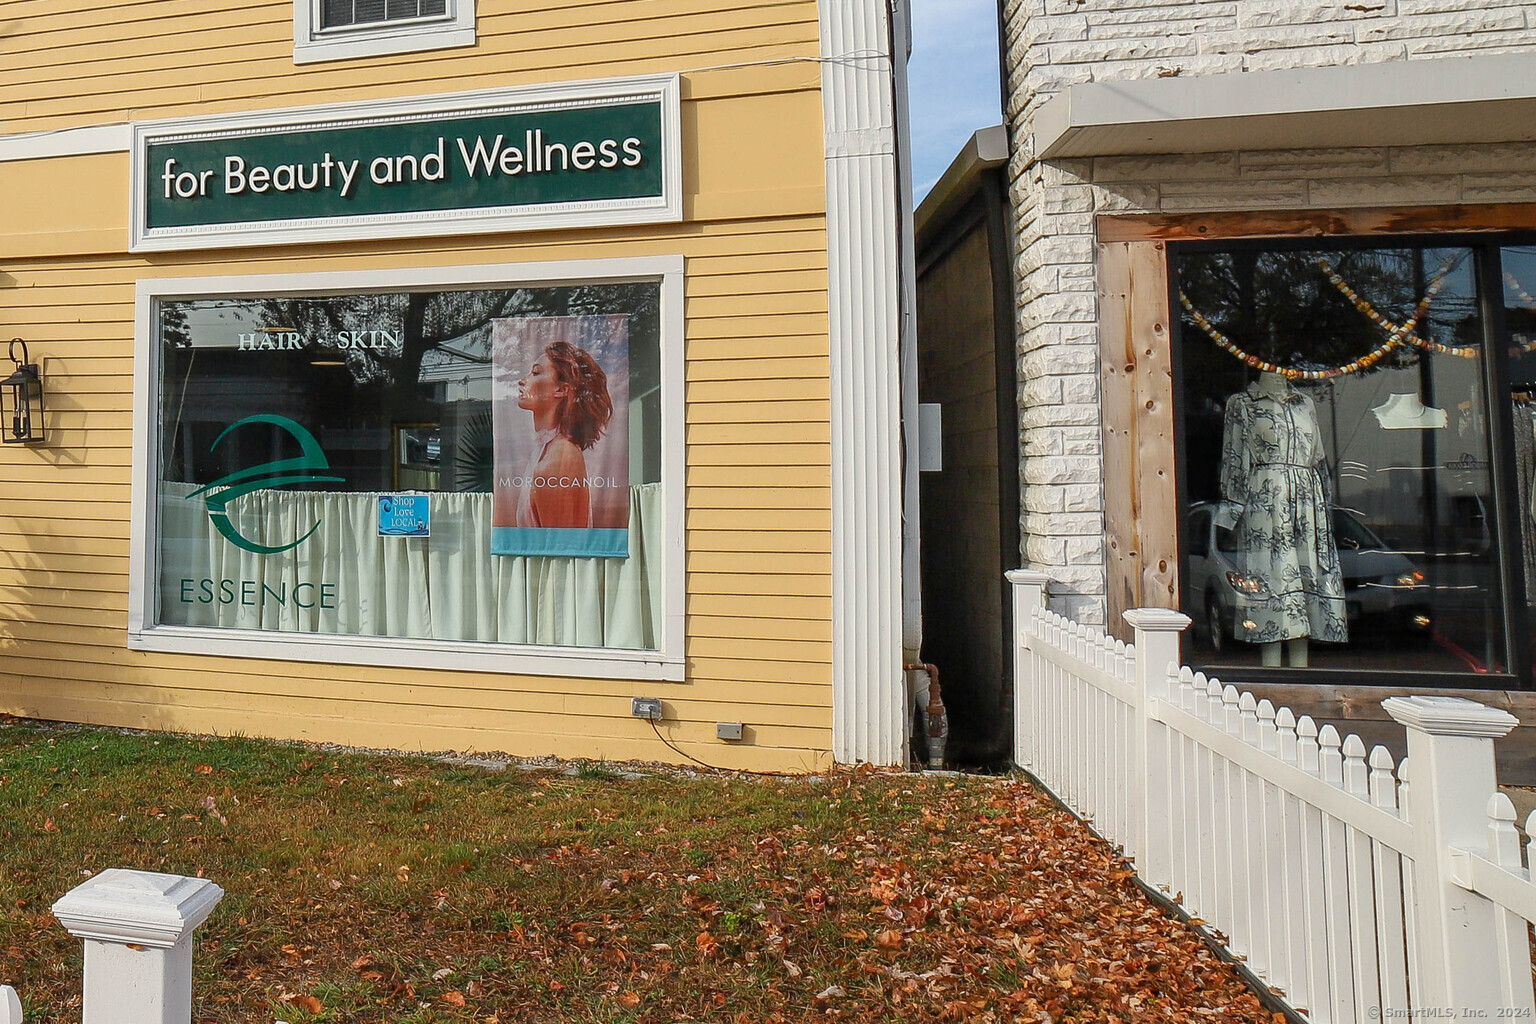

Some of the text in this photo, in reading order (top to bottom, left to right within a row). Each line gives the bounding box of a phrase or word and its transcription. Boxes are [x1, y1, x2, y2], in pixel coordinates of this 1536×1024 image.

[161, 129, 643, 199] for Beauty and Wellness
[237, 330, 399, 351] HAIR SKIN
[393, 496, 415, 508] Shop
[394, 507, 415, 517] Love
[391, 518, 418, 527] LOCAL
[180, 578, 335, 609] ESSENCE
